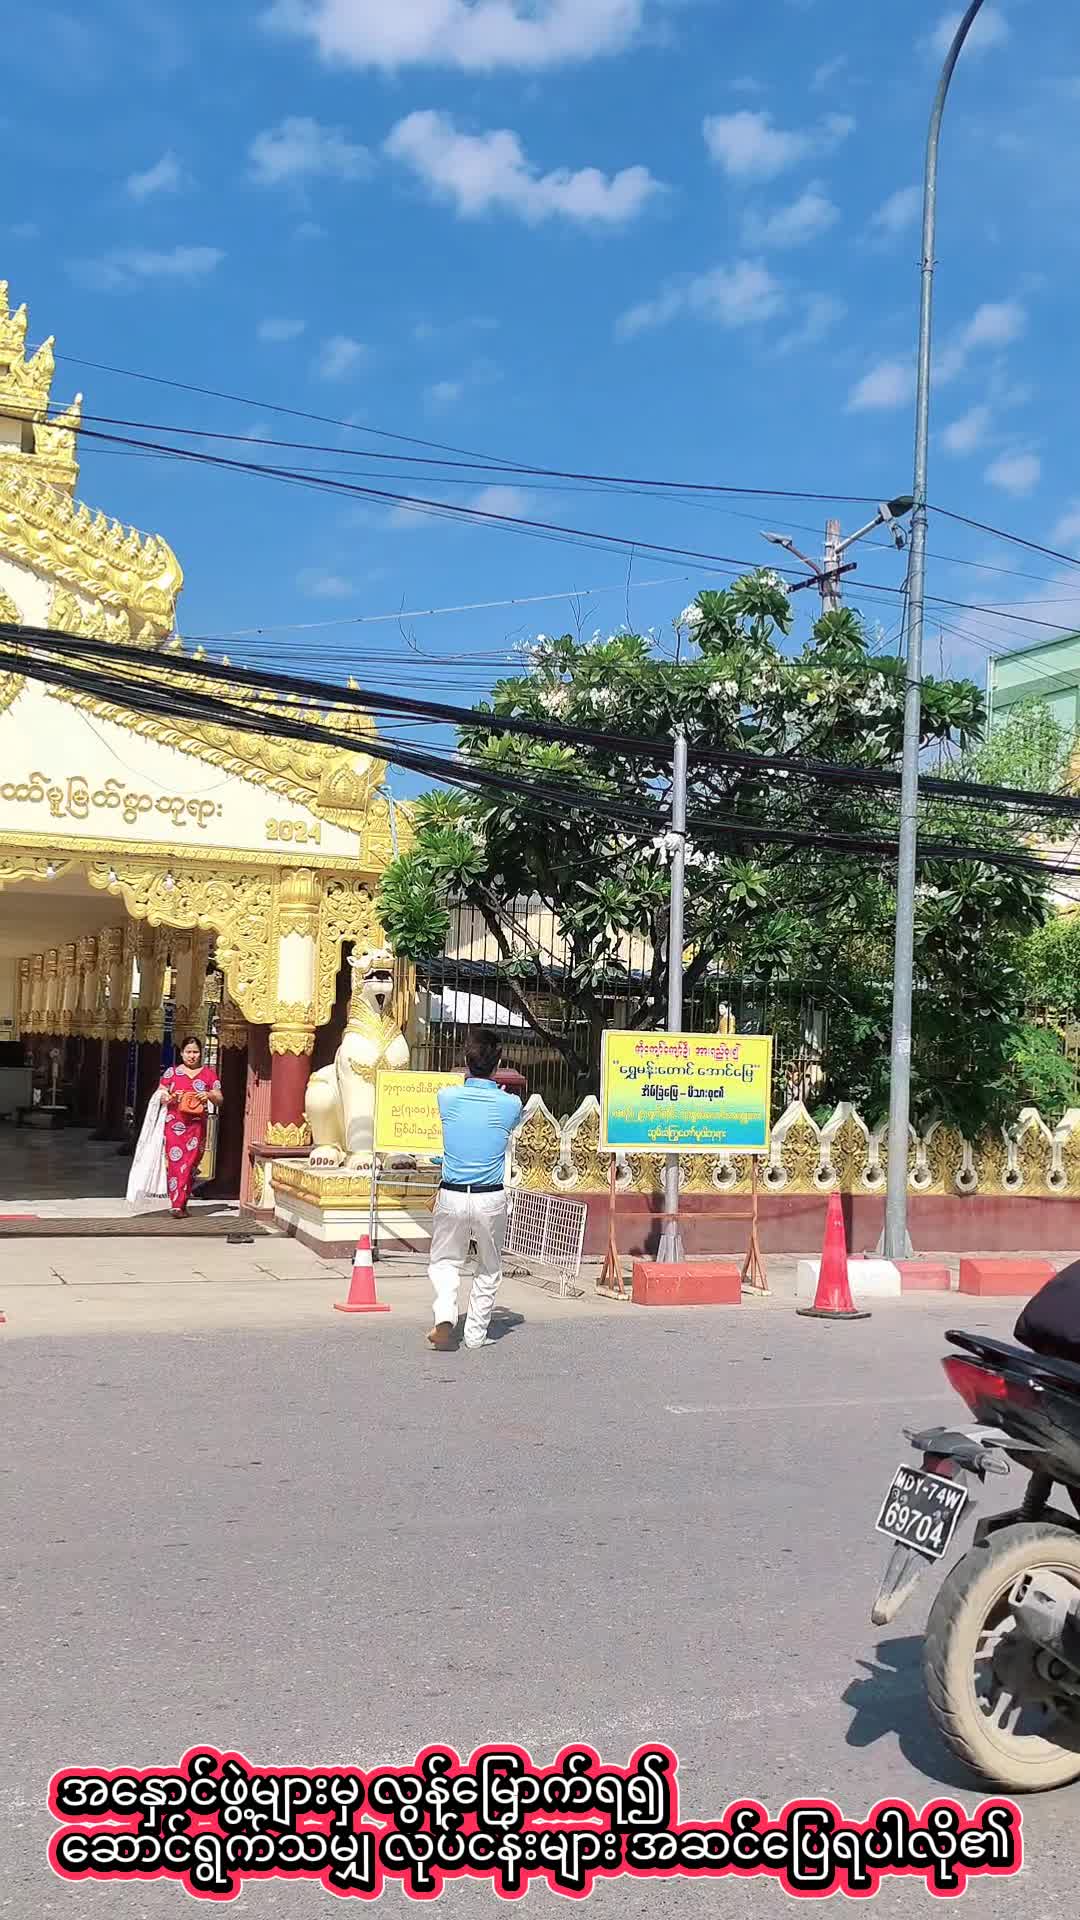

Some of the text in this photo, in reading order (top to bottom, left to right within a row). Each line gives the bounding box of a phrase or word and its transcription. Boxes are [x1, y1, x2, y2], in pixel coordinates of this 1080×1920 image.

[265, 817, 322, 844] 2024
[895, 1471, 961, 1509] MDY-74W
[884, 1502, 945, 1549] 69704
